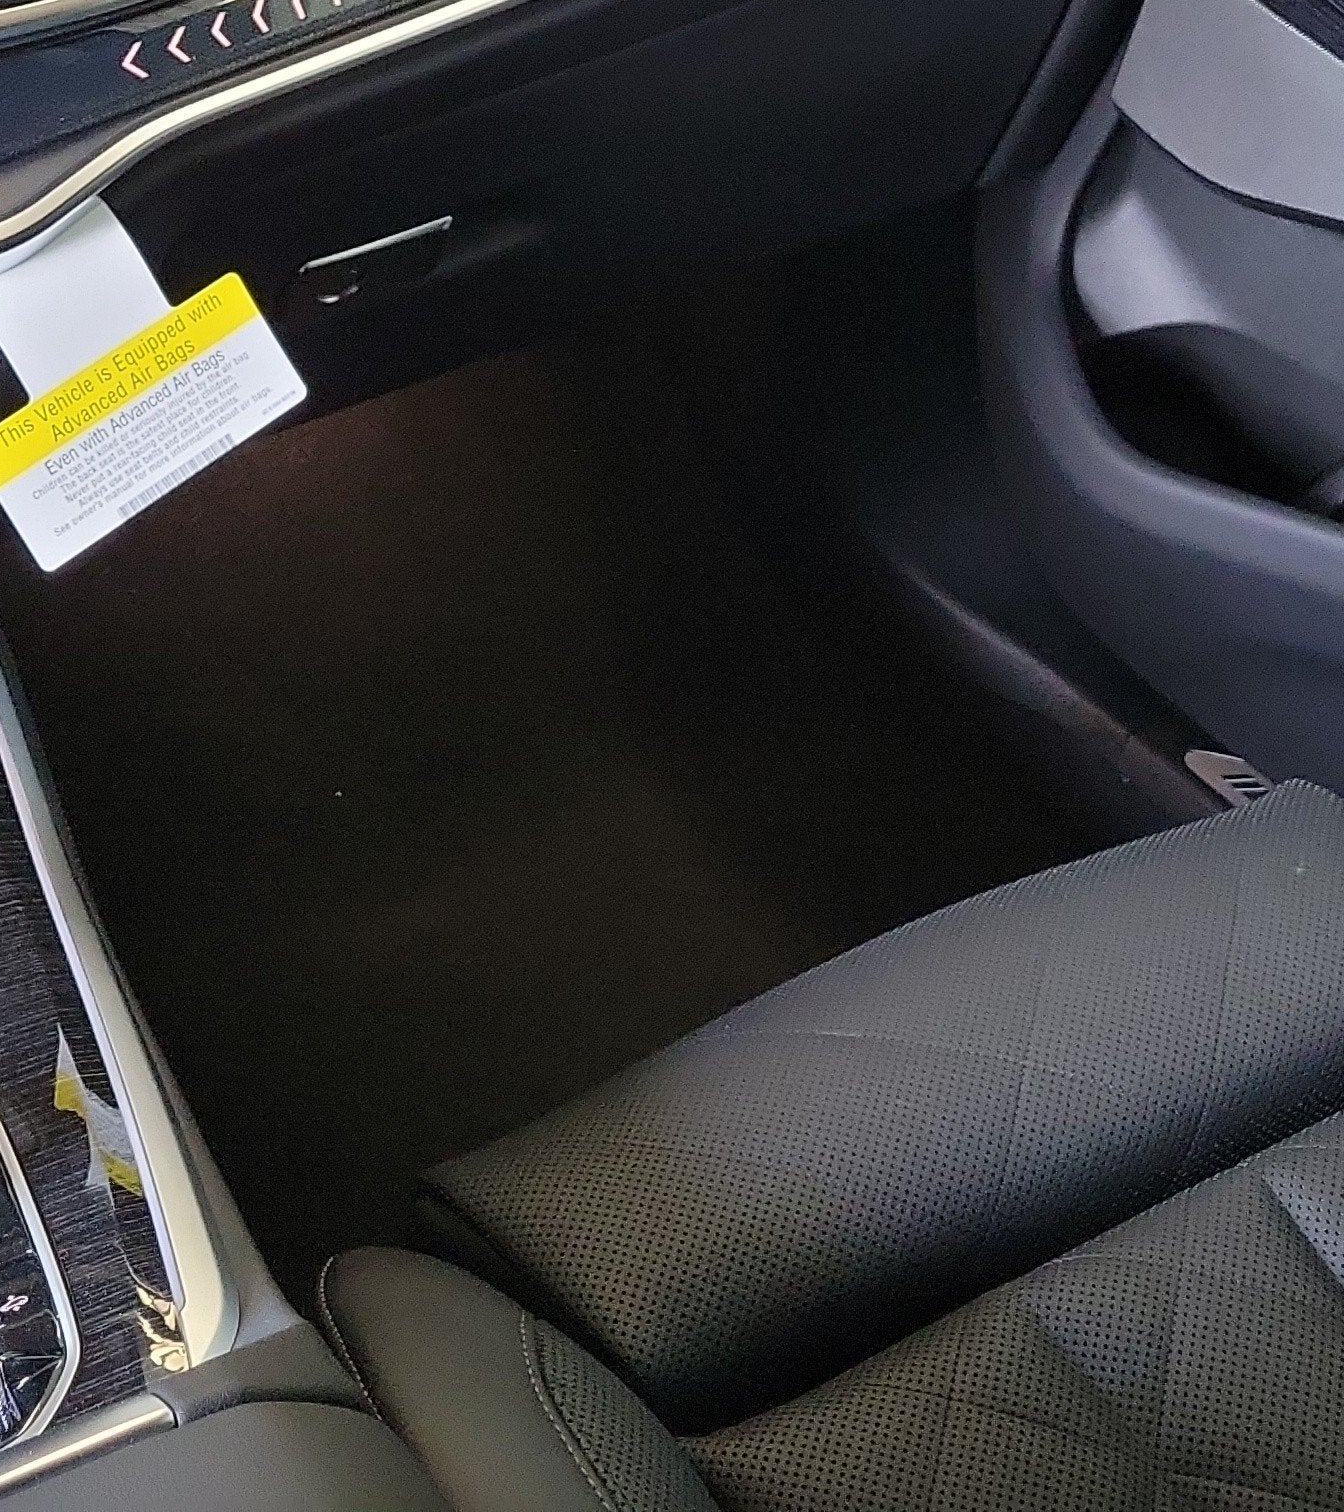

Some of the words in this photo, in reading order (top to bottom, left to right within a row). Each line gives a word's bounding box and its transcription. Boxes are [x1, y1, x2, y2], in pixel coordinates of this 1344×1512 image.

[34, 375, 94, 423] Vehicle
[94, 364, 112, 383] is
[111, 314, 188, 374] Equipped
[185, 291, 221, 322] with
[44, 445, 79, 475] Even
[77, 425, 109, 452] with
[107, 383, 171, 432] Advanced
[169, 369, 193, 390] Air
[191, 347, 227, 379] Bags
[47, 380, 128, 441] Advanced
[126, 363, 155, 389] Air
[153, 336, 197, 374] Bags
[31, 472, 67, 499] Children
[68, 463, 83, 475] can
[207, 370, 219, 381] the
